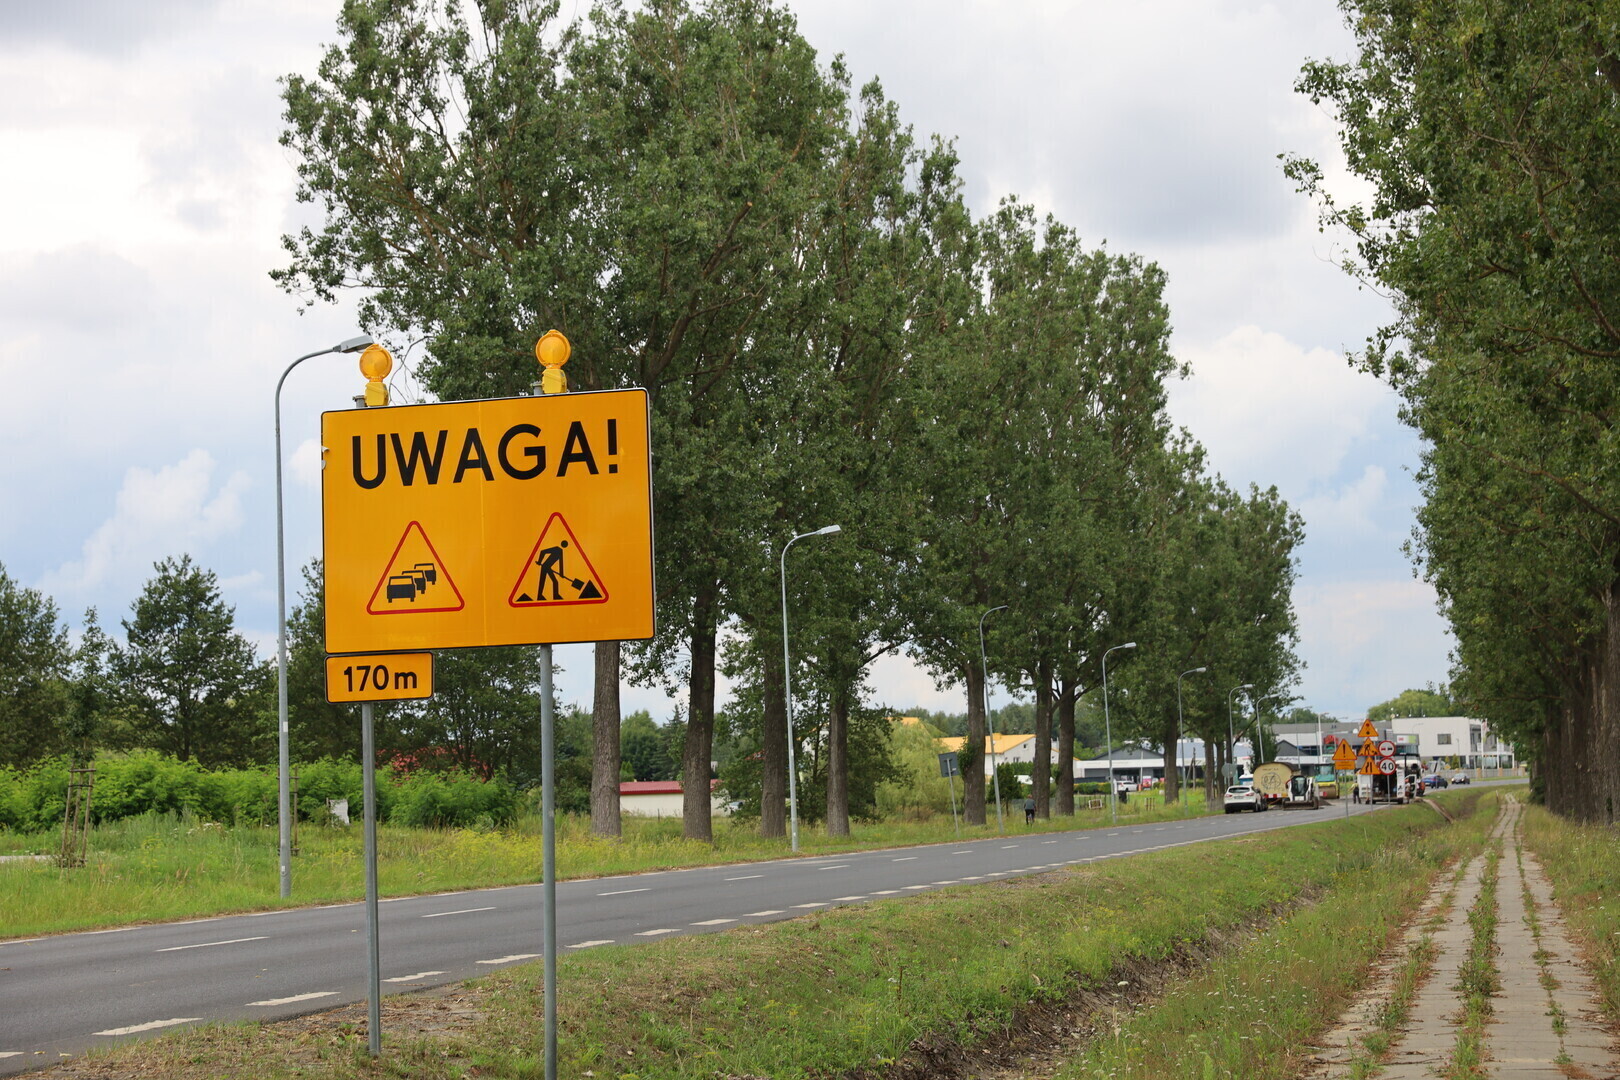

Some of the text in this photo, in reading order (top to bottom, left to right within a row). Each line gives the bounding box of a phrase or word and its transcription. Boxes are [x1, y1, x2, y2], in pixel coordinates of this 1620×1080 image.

[352, 418, 619, 490] UWAGA!
[343, 664, 418, 692] 170 m
[1381, 762, 1394, 771] 40
